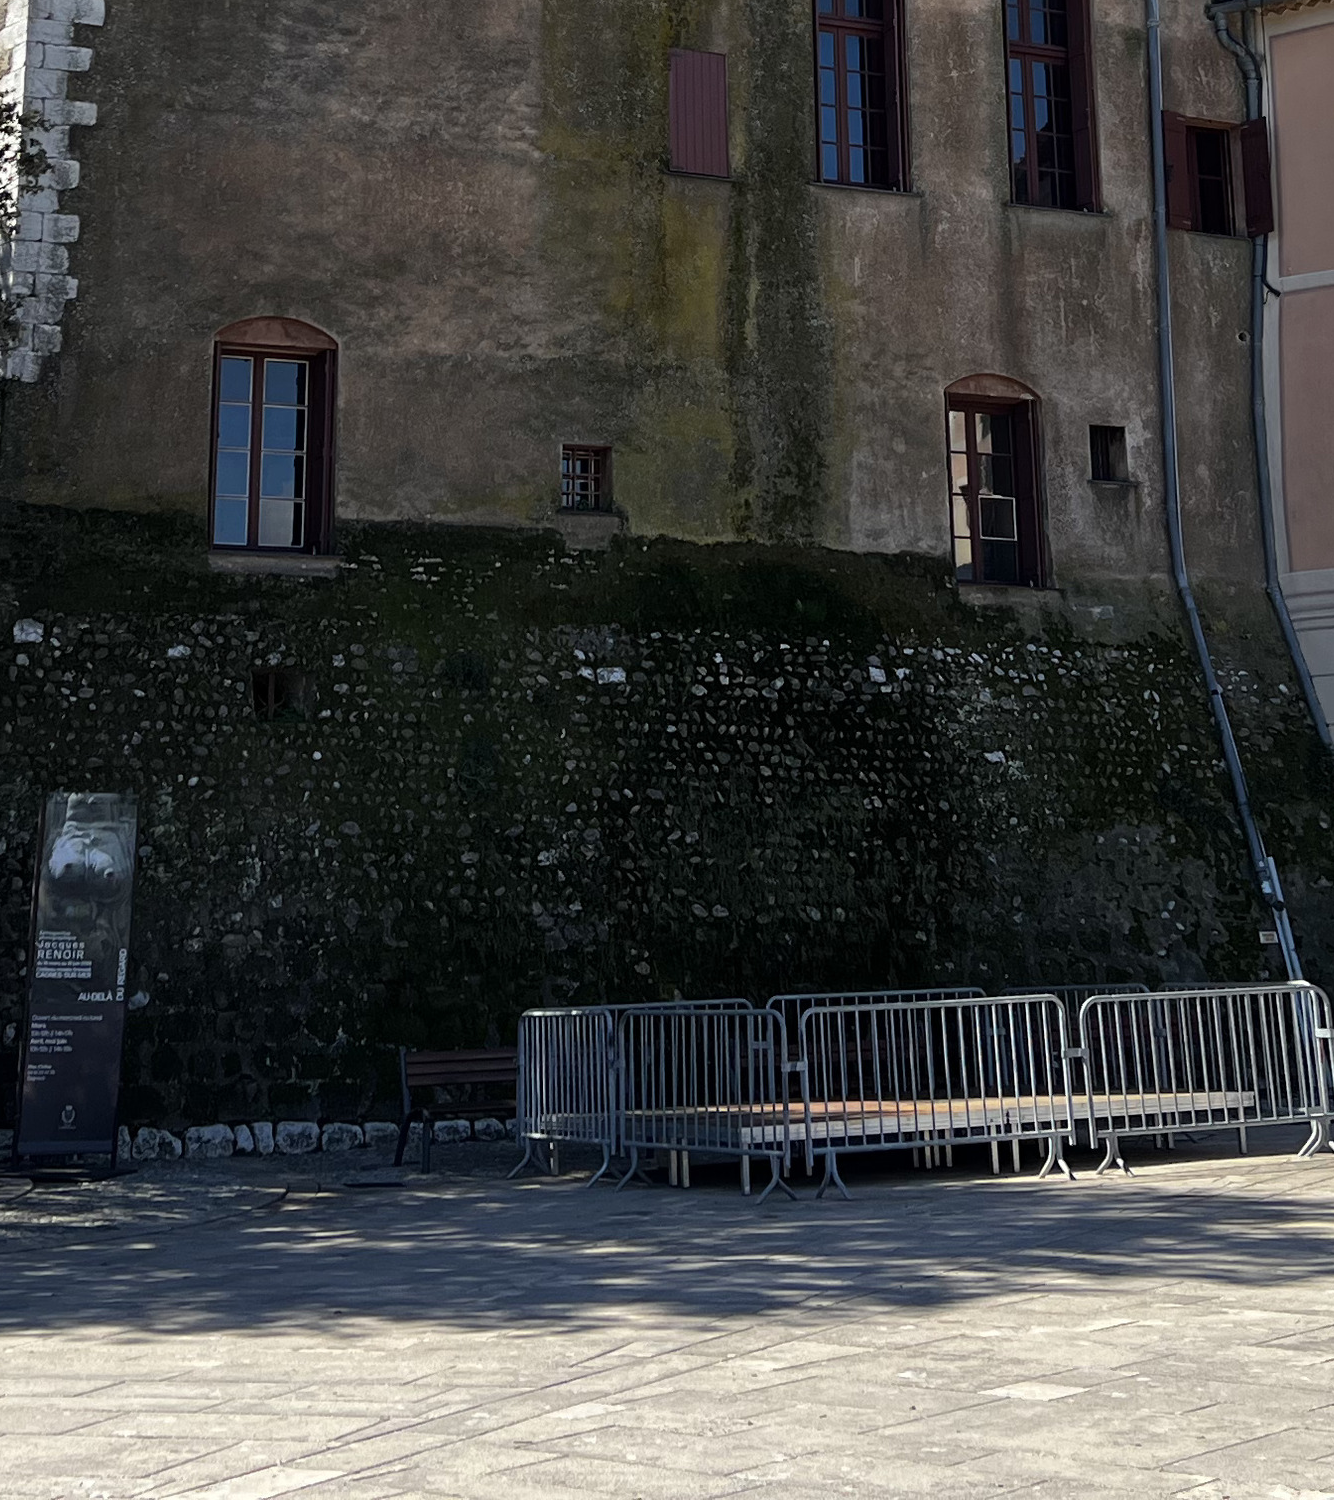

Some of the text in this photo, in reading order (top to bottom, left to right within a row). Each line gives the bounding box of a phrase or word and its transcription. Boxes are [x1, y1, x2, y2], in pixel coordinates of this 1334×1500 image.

[37, 940, 85, 950] Jacques
[36, 949, 85, 960] RENOIR
[116, 948, 128, 1002] DU REGARD
